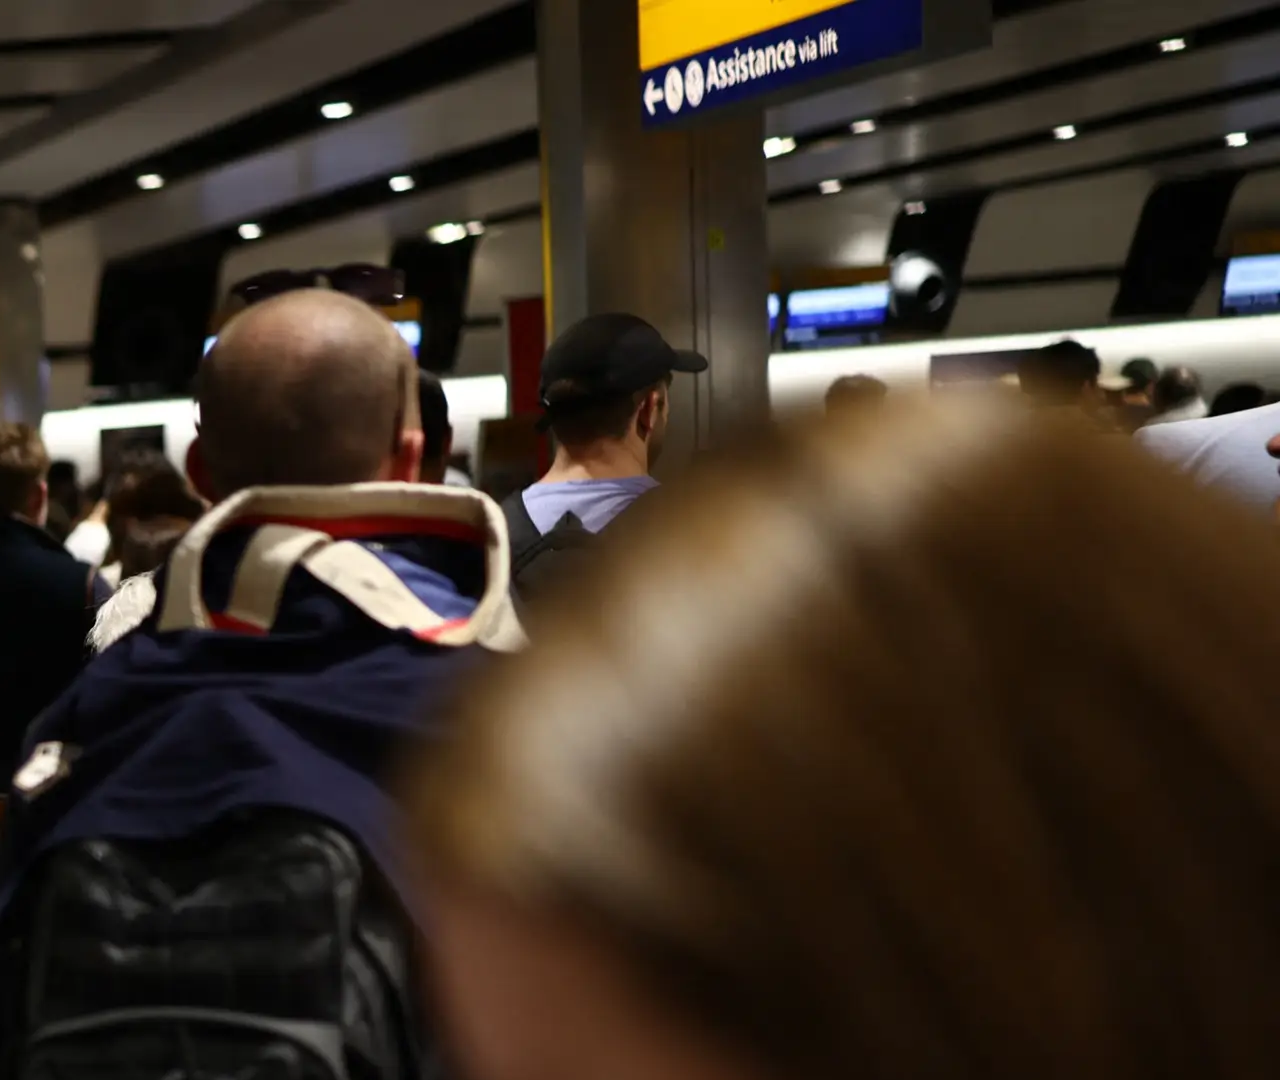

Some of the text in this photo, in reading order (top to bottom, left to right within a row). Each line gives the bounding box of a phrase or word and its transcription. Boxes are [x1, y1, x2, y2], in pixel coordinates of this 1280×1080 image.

[705, 27, 839, 94] Assistance via lift
